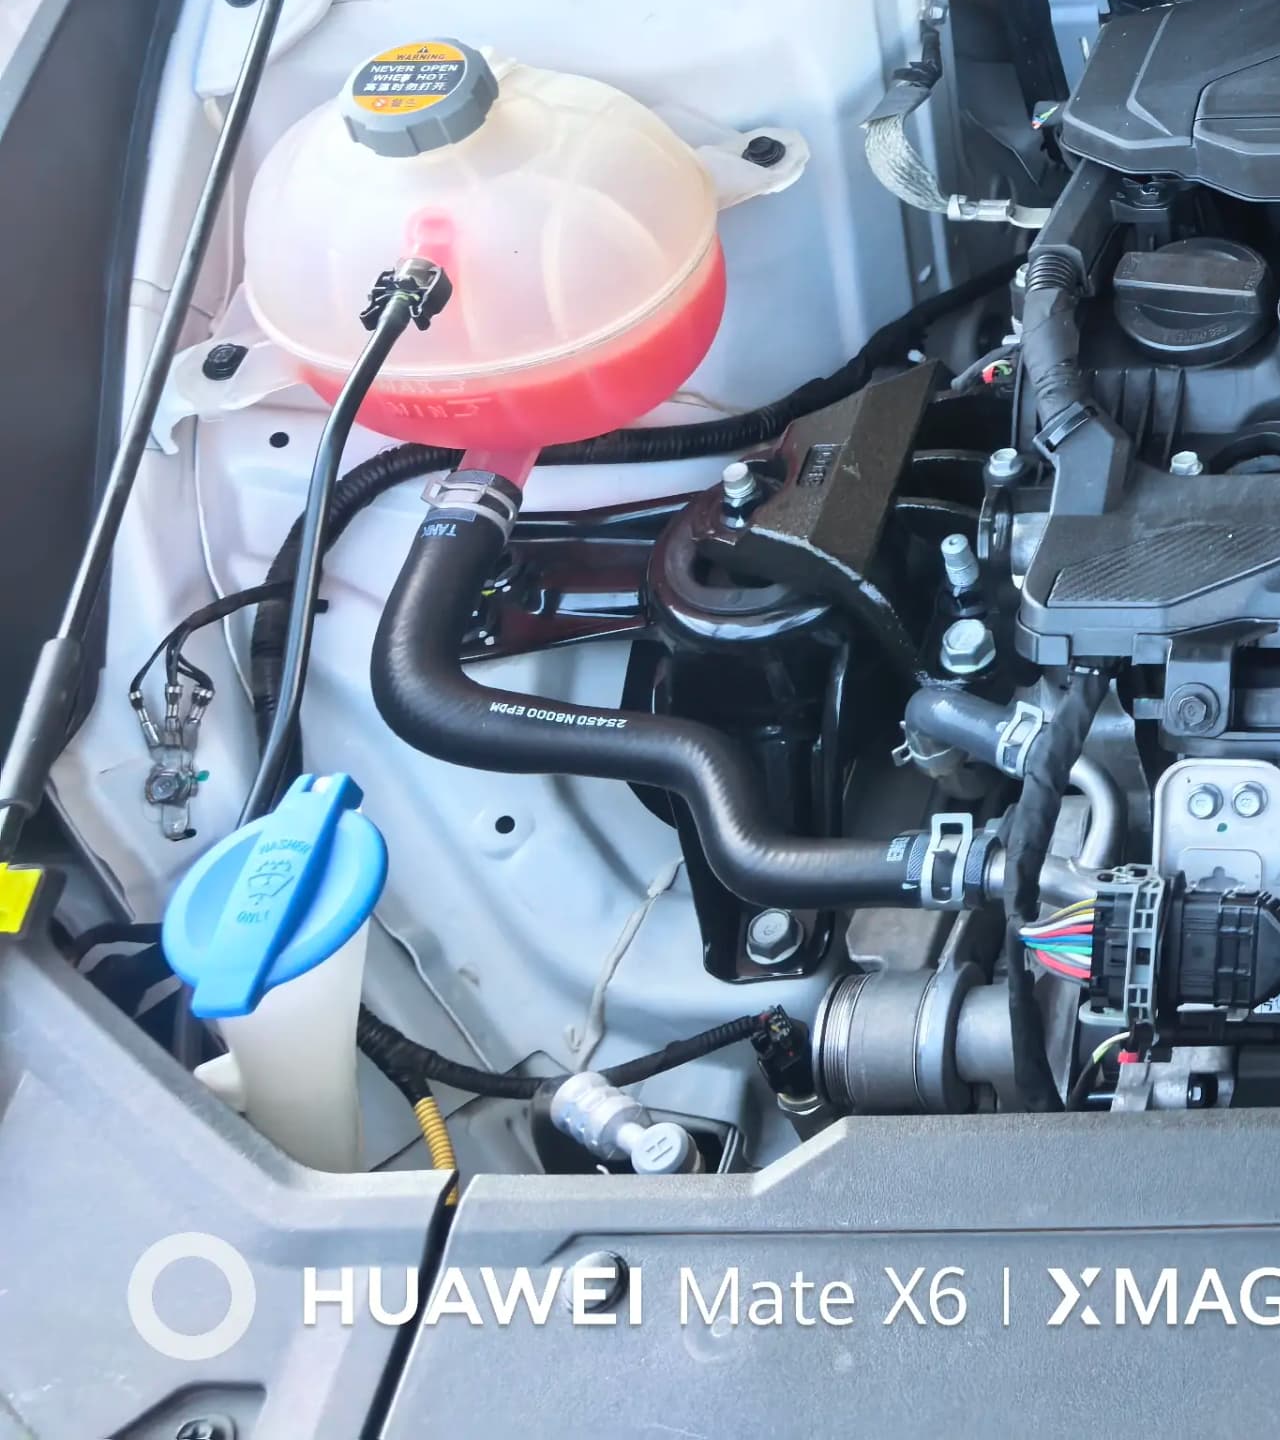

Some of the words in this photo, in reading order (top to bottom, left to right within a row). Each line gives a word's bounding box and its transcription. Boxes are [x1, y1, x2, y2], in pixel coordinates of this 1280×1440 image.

[397, 53, 446, 61] WARNING
[370, 64, 416, 73] NEVER
[420, 64, 459, 72] OPEN
[420, 523, 457, 538] TANK
[489, 701, 526, 716] EPDM
[526, 707, 576, 725] N8000
[576, 714, 628, 729] 25450
